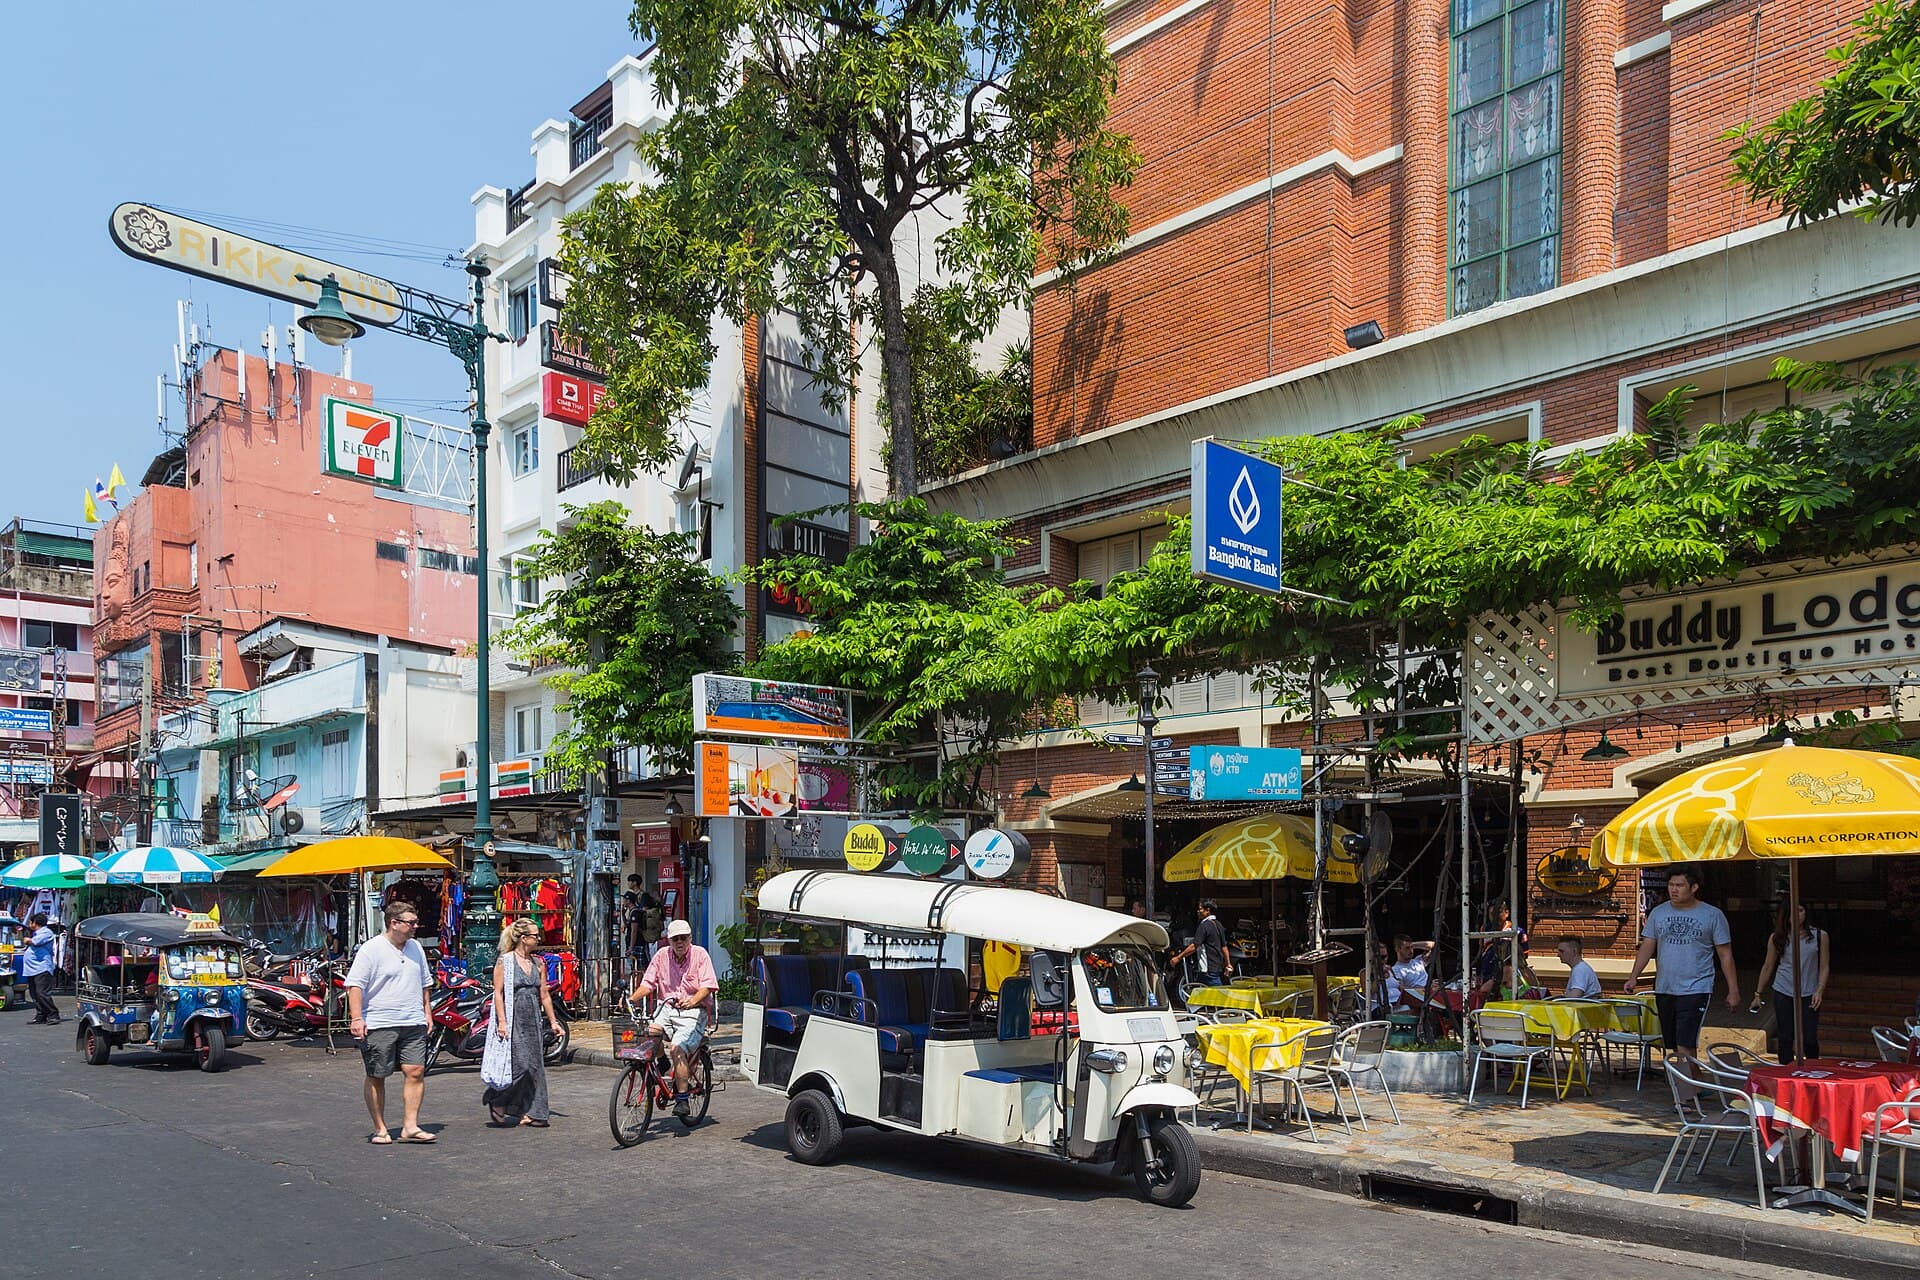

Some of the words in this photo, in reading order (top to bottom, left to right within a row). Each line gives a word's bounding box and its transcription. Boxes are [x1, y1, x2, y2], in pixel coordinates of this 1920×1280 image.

[179, 227, 313, 294] RIKKA
[557, 398, 572, 407] CIMB
[346, 410, 391, 477] 7
[1208, 545, 1252, 570] Bangkok
[1253, 558, 1278, 578] Bank
[1597, 600, 1742, 655] Buddy
[1608, 662, 1673, 682] Best
[1689, 644, 1835, 674] Boutique
[1226, 752, 1249, 765] กรุงไทย
[1226, 765, 1240, 774] KTB
[1262, 773, 1288, 788] ATM
[851, 832, 879, 855] Buddy
[1765, 834, 1815, 845] SINGHA
[1818, 831, 1919, 843] CORPORATION
[662, 867, 675, 877] ATM
